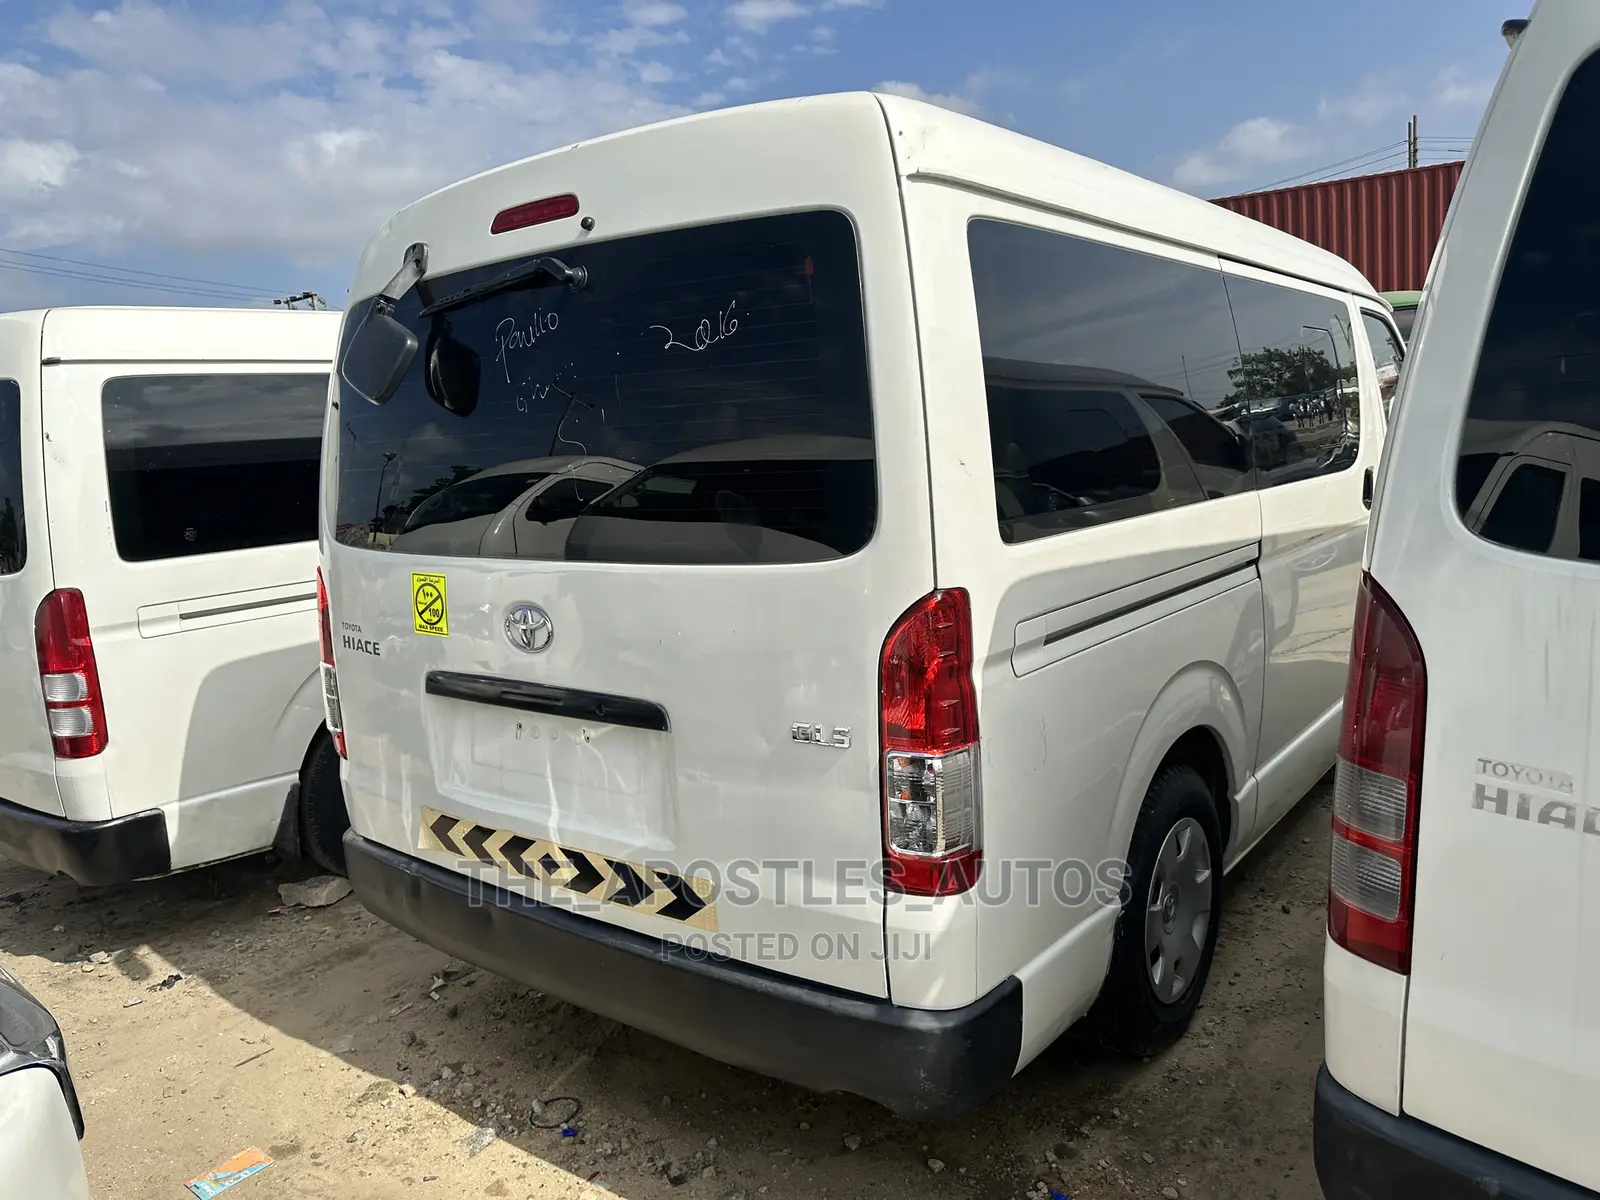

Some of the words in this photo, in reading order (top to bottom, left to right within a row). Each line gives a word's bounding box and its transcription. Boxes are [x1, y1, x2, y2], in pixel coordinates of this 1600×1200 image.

[649, 299, 739, 352] 2016
[428, 607, 440, 618] 100
[341, 621, 362, 633] TOYOTA
[342, 634, 381, 656] HIACE
[791, 721, 851, 749] GLS
